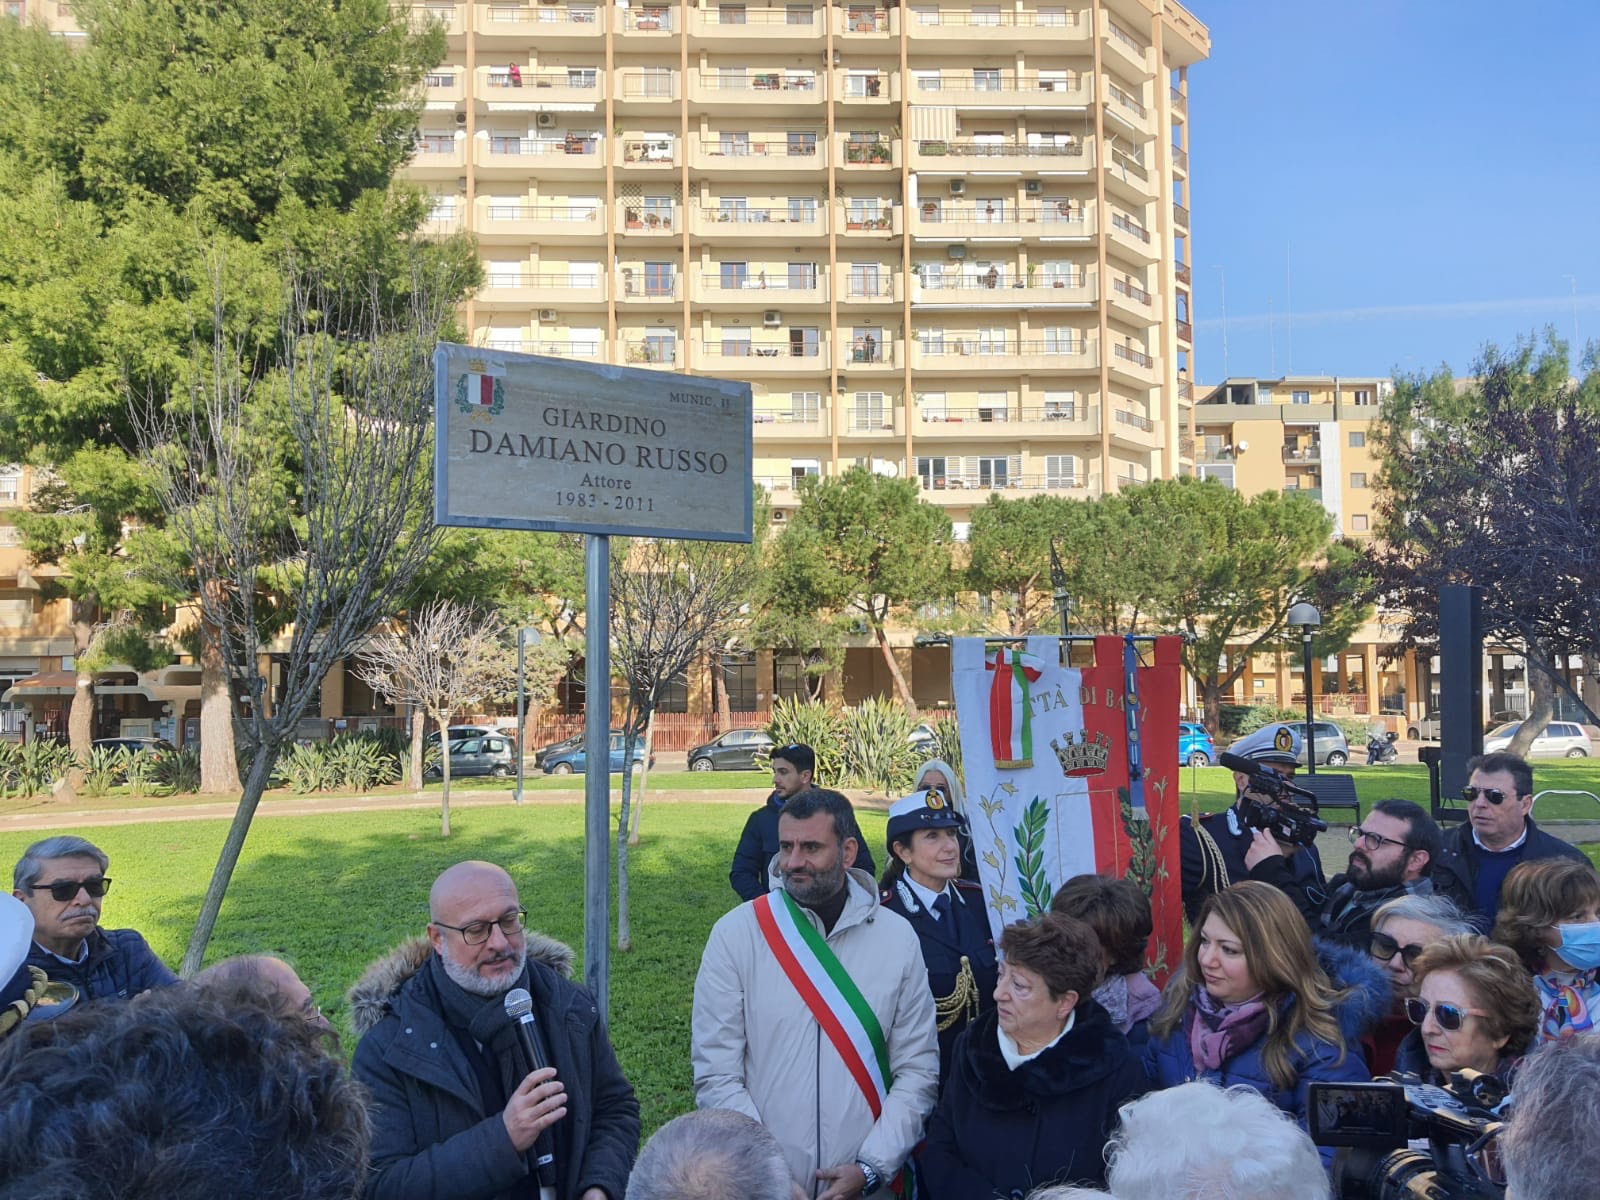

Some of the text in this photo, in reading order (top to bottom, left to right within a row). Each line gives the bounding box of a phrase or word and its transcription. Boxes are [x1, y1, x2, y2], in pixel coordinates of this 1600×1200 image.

[669, 391, 717, 408] MUNIC.
[542, 406, 667, 438] GIARDINO
[469, 428, 729, 475] DAMIANO RUSSO
[579, 472, 633, 490] Attore
[556, 491, 597, 508] 1983
[614, 495, 655, 512] 2011
[1079, 686, 1098, 706] DI
[1105, 688, 1148, 722] BAI
